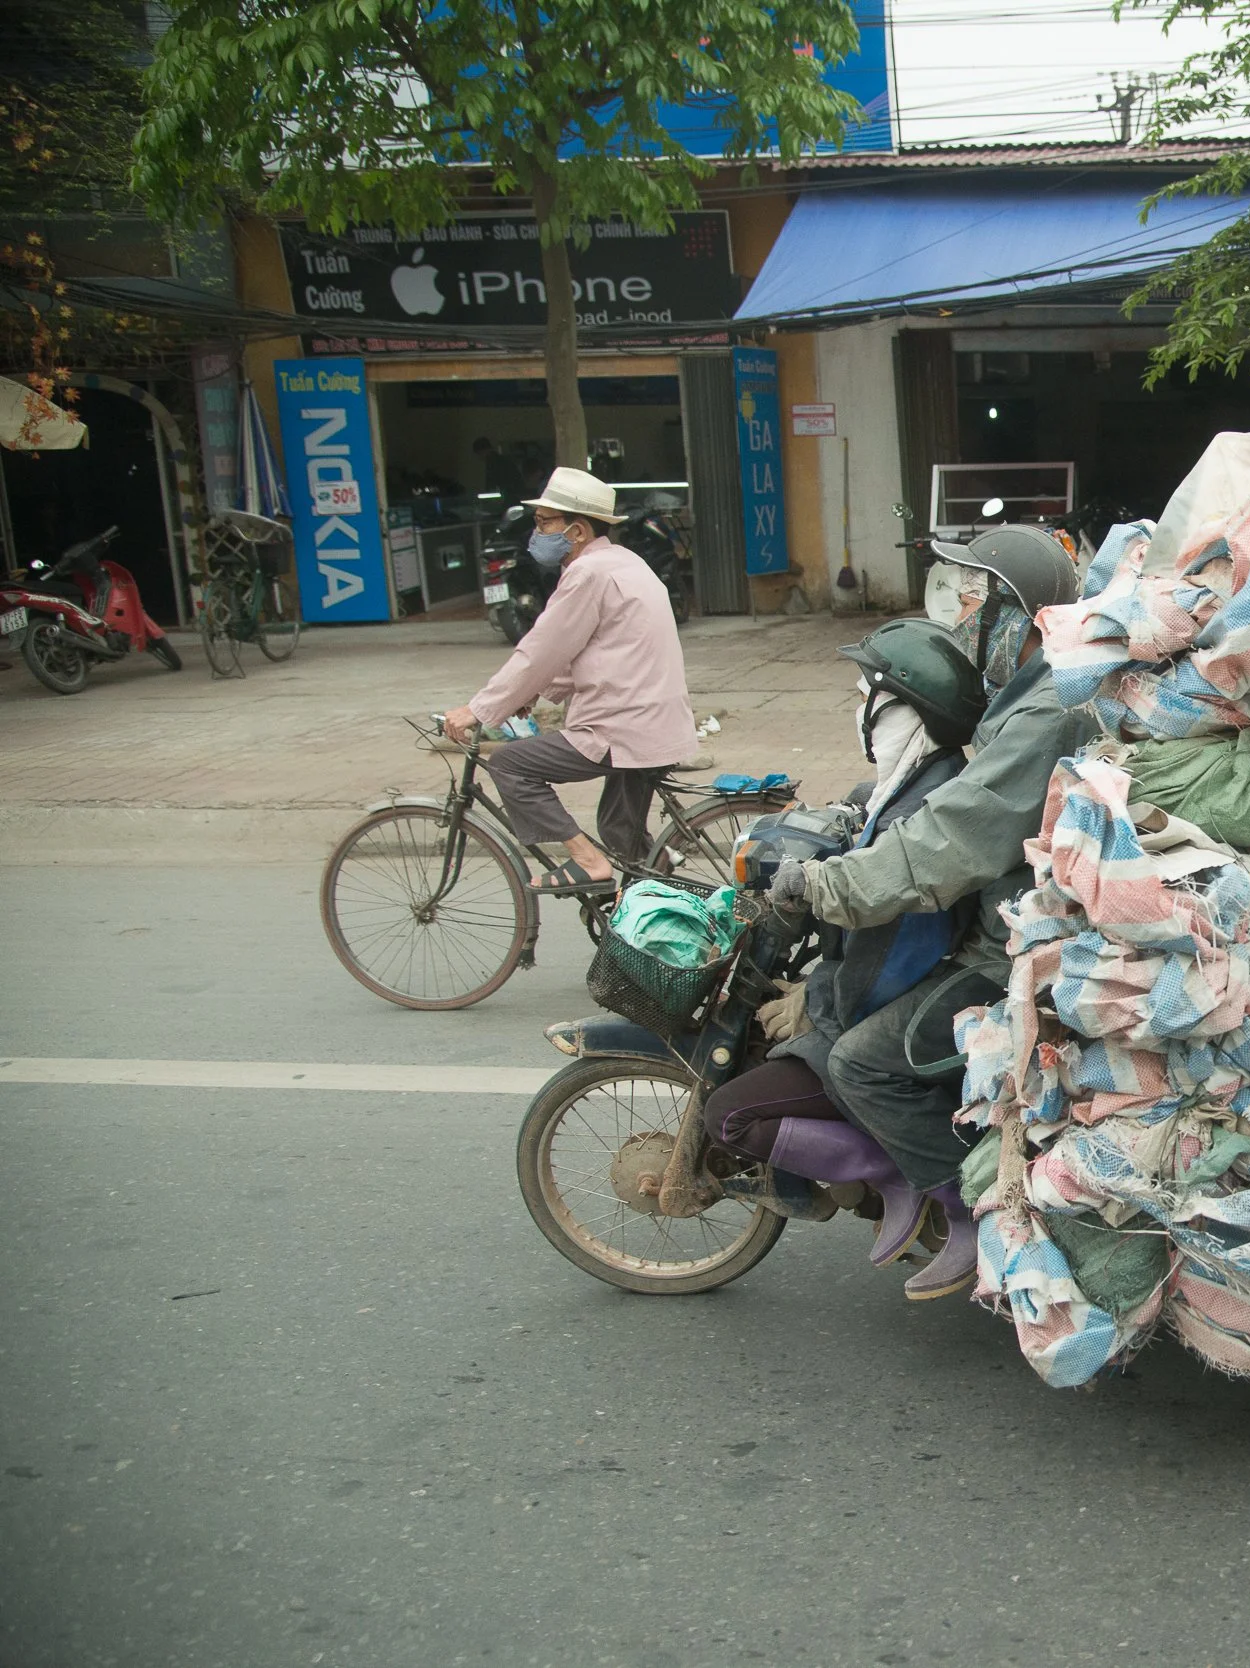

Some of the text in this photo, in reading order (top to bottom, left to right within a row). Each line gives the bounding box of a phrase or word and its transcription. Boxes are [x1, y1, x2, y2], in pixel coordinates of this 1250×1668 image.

[300, 246, 350, 274] Tuấn
[305, 284, 365, 313] Cường
[749, 419, 774, 451] GA
[753, 463, 775, 494] LA
[332, 487, 357, 505] 50%
[754, 504, 776, 536] XY
